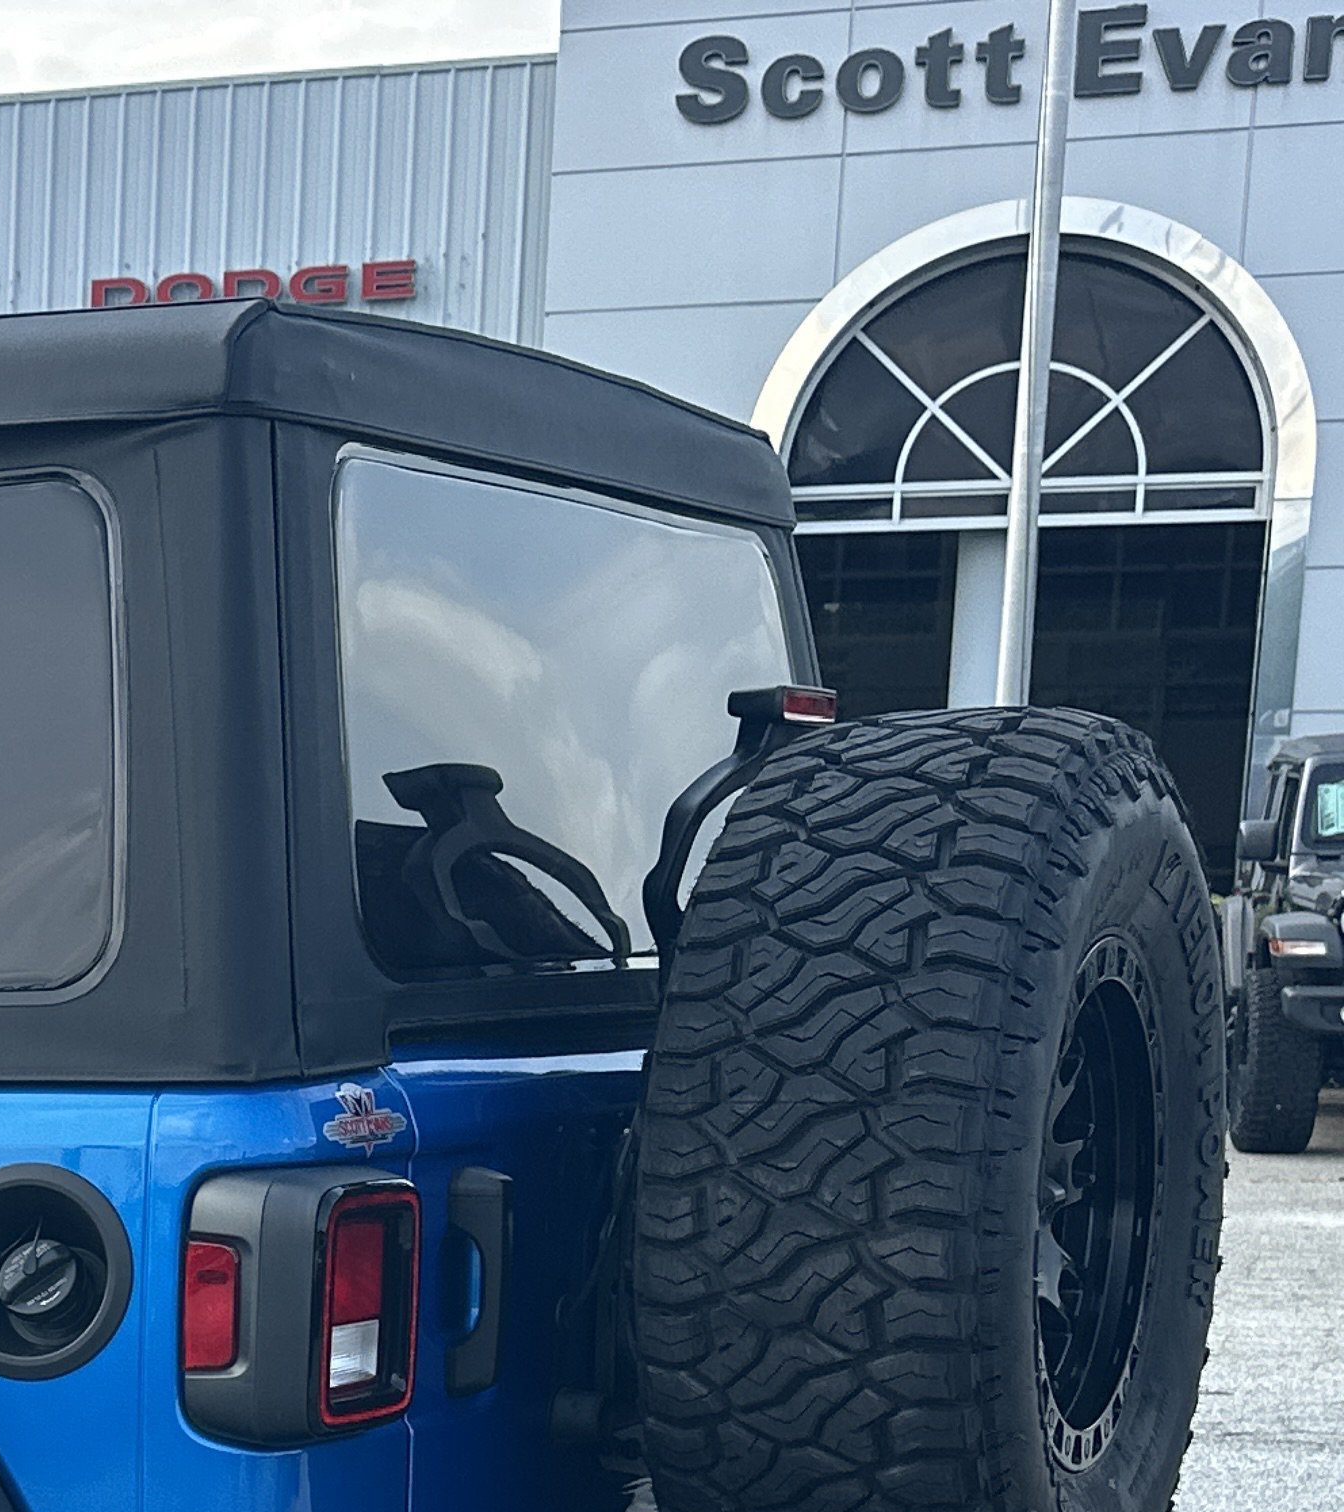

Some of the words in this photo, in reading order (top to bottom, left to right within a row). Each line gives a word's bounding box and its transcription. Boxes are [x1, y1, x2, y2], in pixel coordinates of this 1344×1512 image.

[675, 23, 1026, 125] Scott
[90, 260, 416, 308] DODGE
[1170, 869, 1222, 1066] VENOM
[1185, 1074, 1224, 1309] POWER
